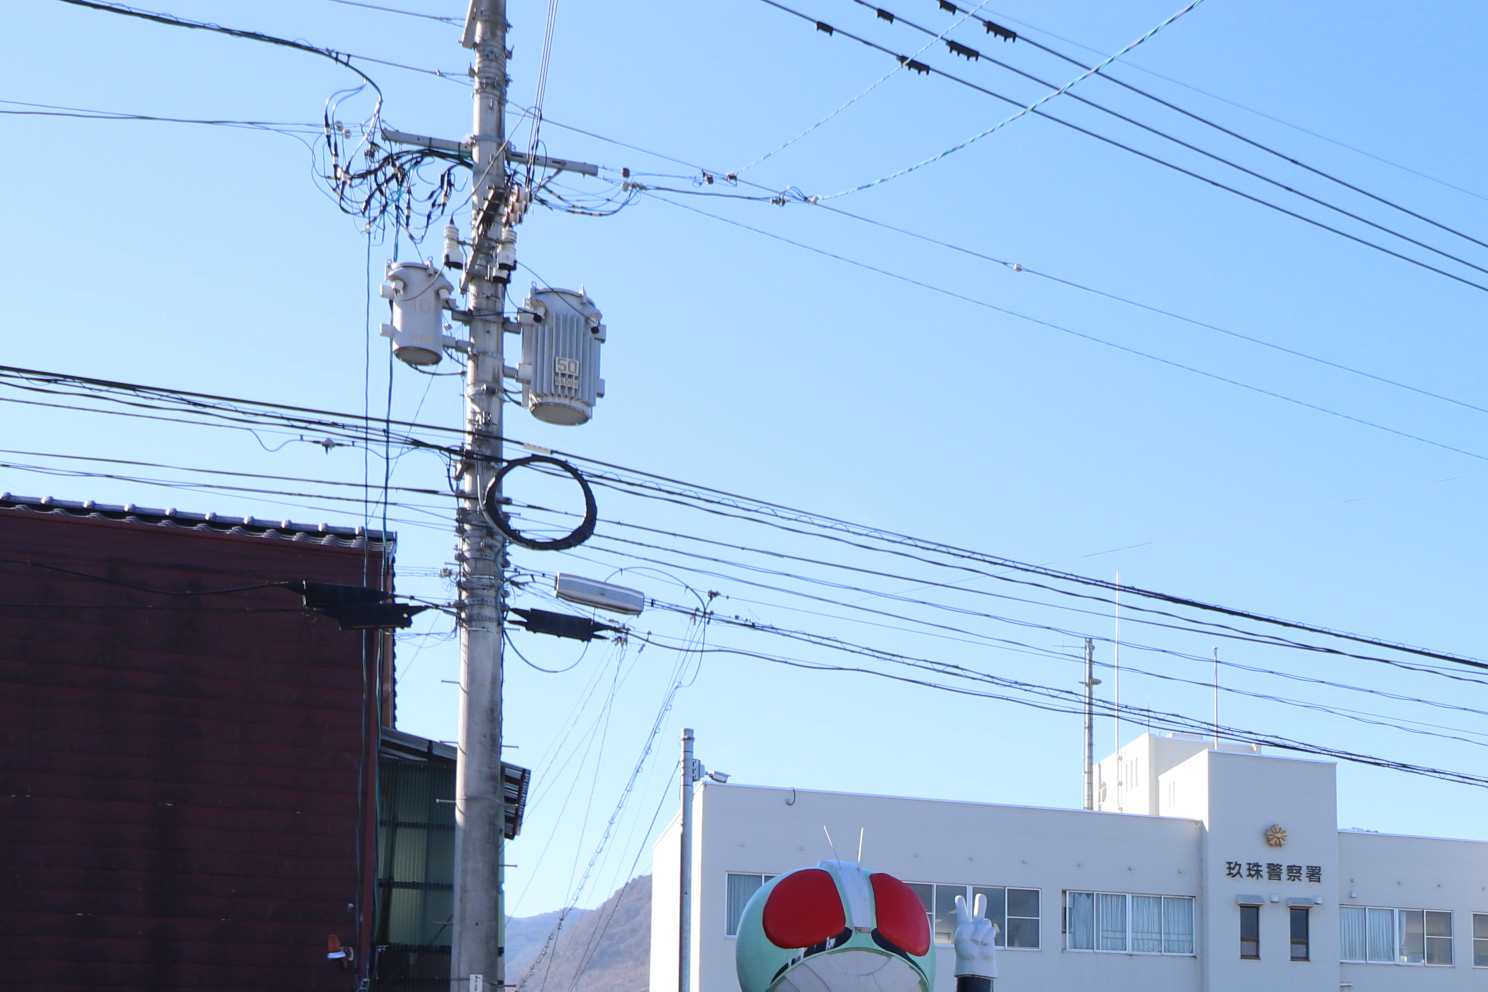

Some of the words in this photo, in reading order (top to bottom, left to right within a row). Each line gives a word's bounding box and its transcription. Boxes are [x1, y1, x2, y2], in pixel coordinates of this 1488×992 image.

[557, 357, 578, 374] 50
[1226, 861, 1322, 883] 玖珠警察署
